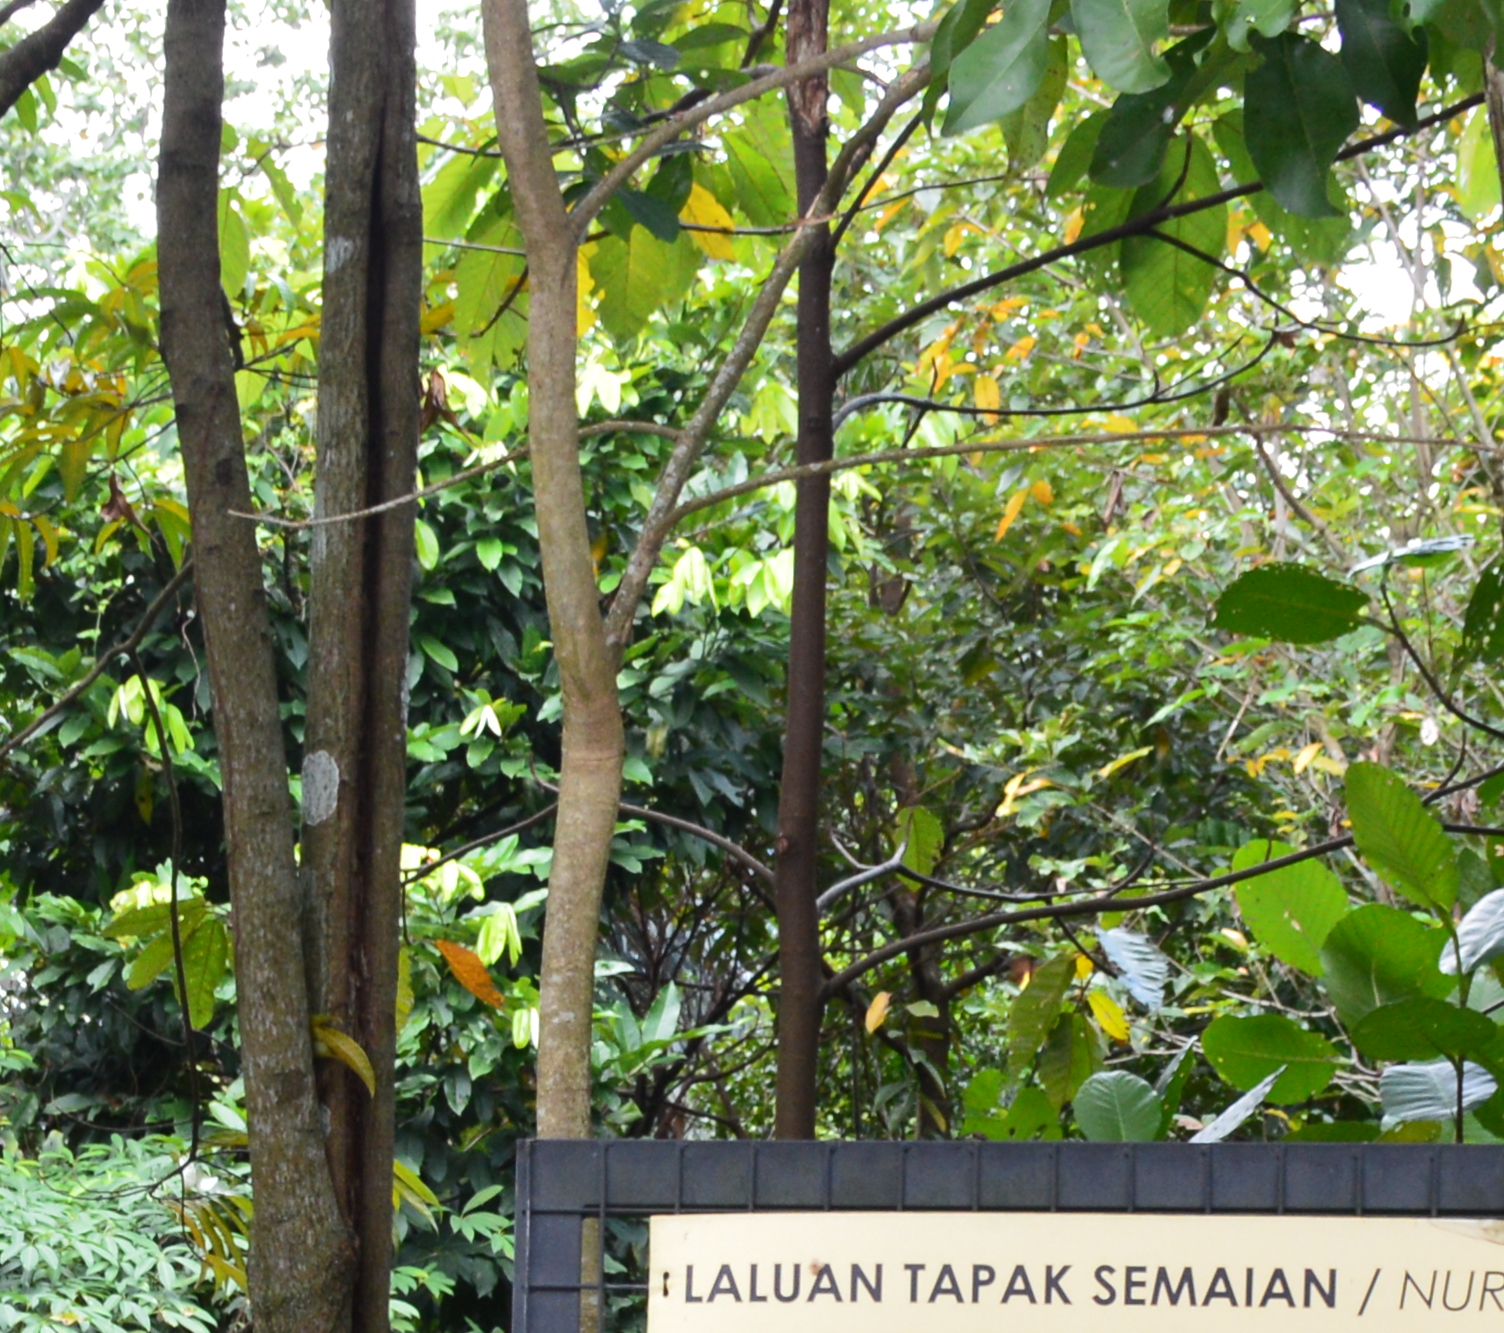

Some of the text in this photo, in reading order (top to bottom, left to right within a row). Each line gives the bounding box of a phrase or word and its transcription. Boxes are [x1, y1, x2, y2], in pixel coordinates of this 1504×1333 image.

[685, 1261, 882, 1304] LALUAN
[905, 1263, 1070, 1304] TAPAK
[1094, 1265, 1336, 1308] SEMAIAN
[1359, 1268, 1379, 1315] /
